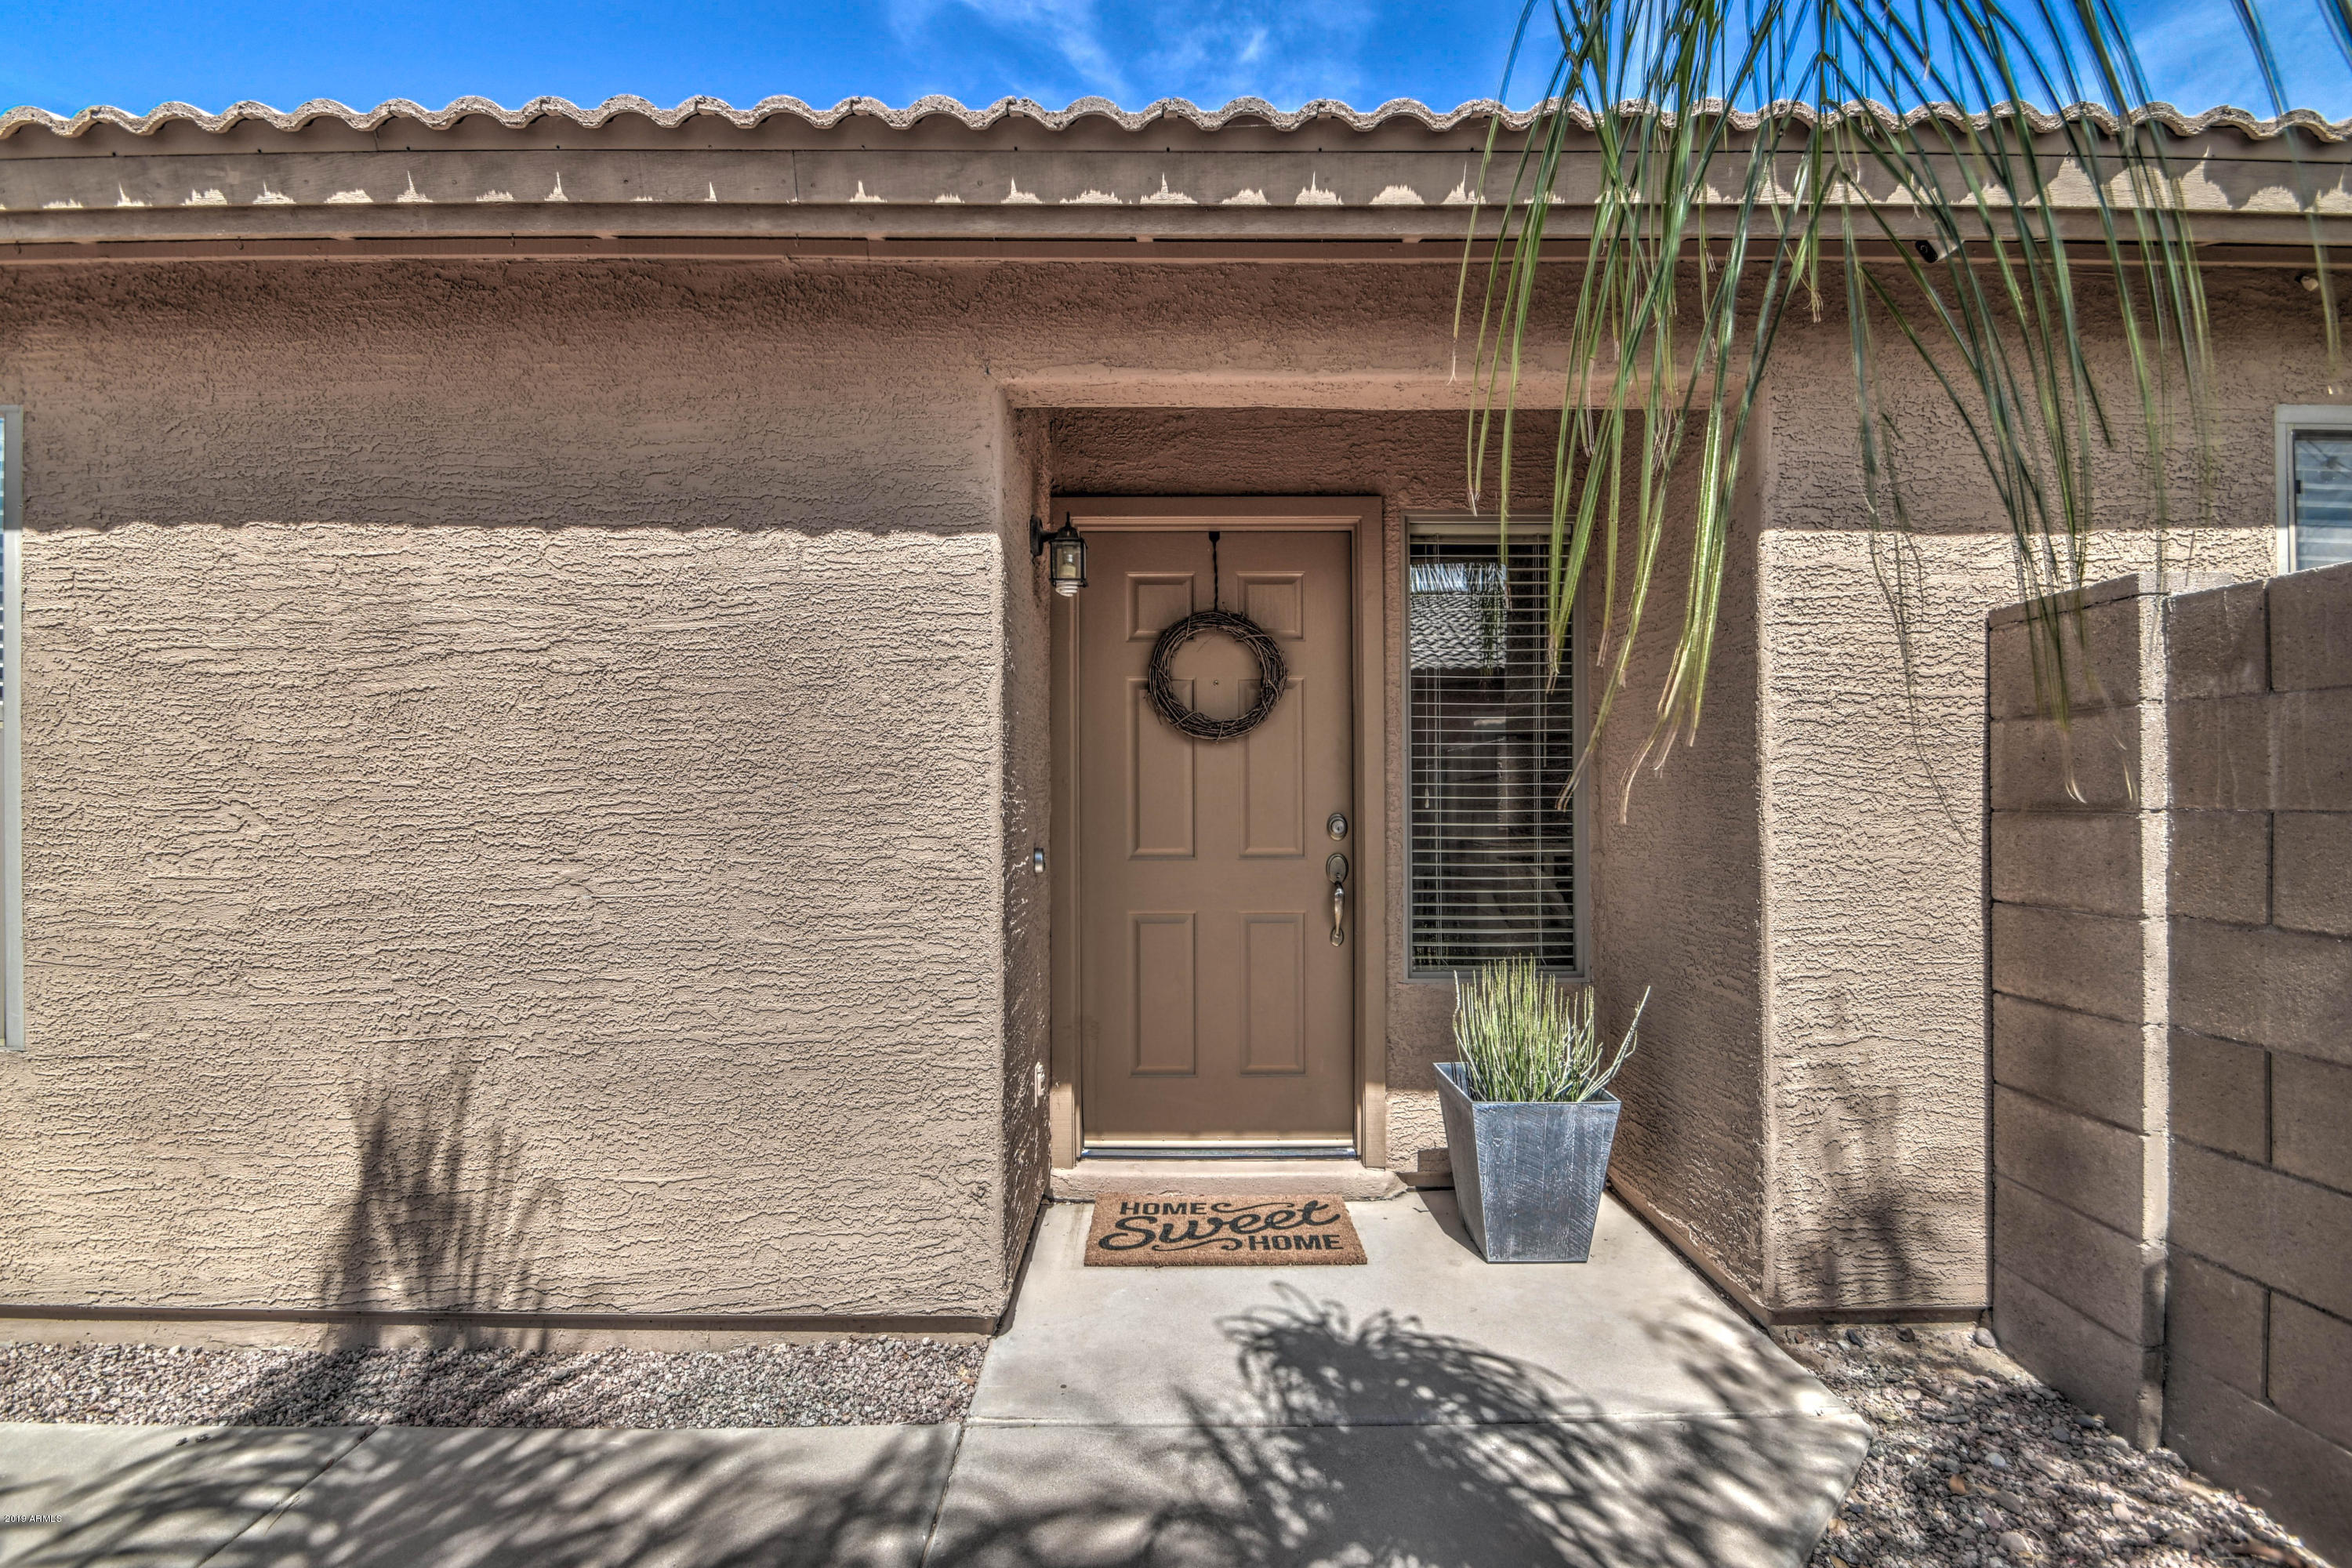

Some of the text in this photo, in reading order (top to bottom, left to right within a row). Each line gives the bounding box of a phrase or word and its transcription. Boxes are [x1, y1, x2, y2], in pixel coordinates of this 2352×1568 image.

[1120, 1202, 1207, 1215] HOME
[1098, 1200, 1341, 1250] Sweet
[1248, 1234, 1344, 1250] HOME
